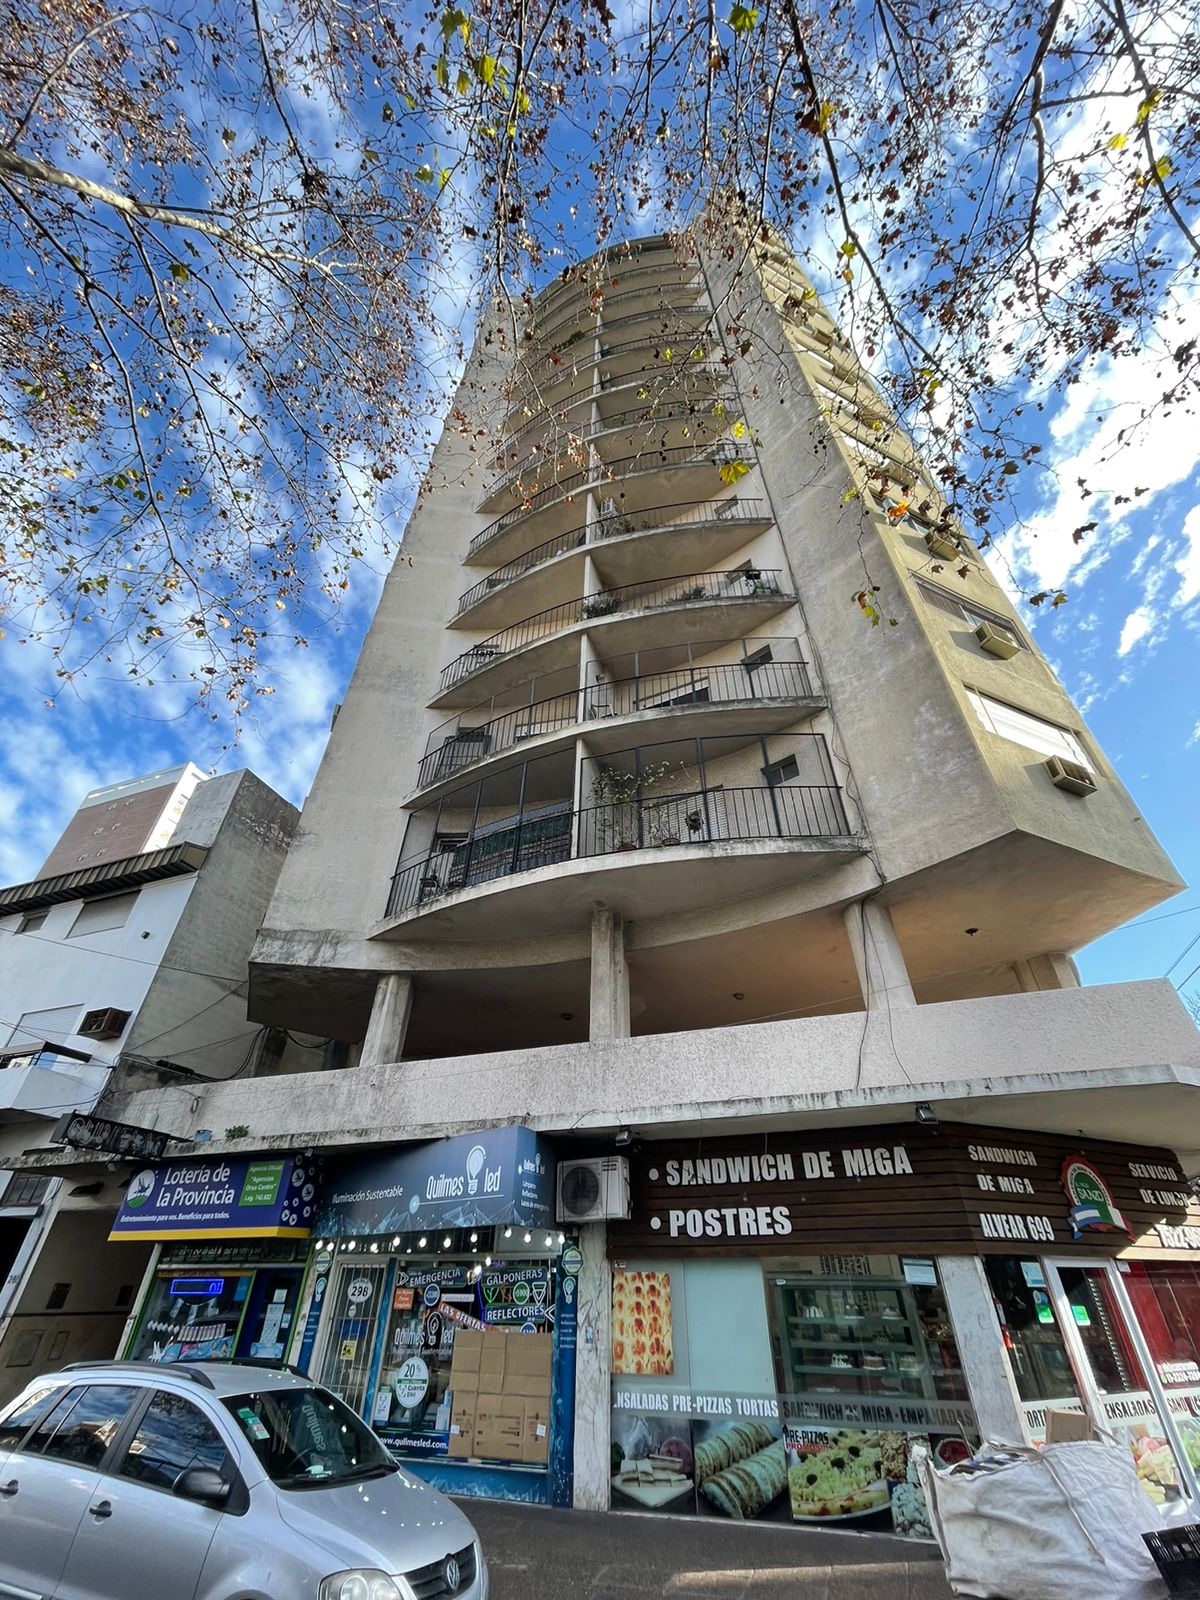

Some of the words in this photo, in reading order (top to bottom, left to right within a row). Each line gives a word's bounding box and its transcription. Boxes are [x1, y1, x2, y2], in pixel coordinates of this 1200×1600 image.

[968, 1145, 1038, 1166] SANDWICH
[163, 1163, 209, 1186] Lotería
[212, 1163, 231, 1183] de
[666, 1153, 795, 1186] SANDWICH
[802, 1151, 836, 1180] DE
[841, 1146, 914, 1177] MIGA
[1128, 1162, 1178, 1181] SERVICIO
[426, 1173, 464, 1200] Quilmes
[484, 1166, 502, 1193] led
[976, 1174, 997, 1191] DE
[156, 1188, 171, 1207] la
[171, 1183, 235, 1207] Provincia
[331, 1191, 366, 1204] Iluminación
[366, 1185, 404, 1201] Sustentable
[1139, 1189, 1157, 1204] DE
[1155, 1190, 1190, 1208] LUNCH
[156, 1214, 168, 1222] para
[178, 1212, 202, 1221] Beneficios
[202, 1213, 214, 1222] para
[669, 1206, 793, 1238] POSTRES
[980, 1213, 1028, 1239] ALVEAR
[1026, 1215, 1055, 1241] 699
[410, 1268, 460, 1287] EMERGENCIA
[486, 1269, 543, 1286] GALPONERAS
[351, 1286, 369, 1297] 298
[440, 1304, 455, 1317] LAS
[456, 1312, 487, 1332] OFERTAS
[487, 1305, 545, 1320] REFLECTORES
[394, 1327, 425, 1346] Quilmes
[441, 1327, 454, 1344] led
[404, 1363, 416, 1378] 20
[672, 1394, 733, 1415] PRE-PIZZAS
[736, 1398, 779, 1418] TORTAS
[1104, 1400, 1156, 1420] ENSALADAS
[861, 1405, 894, 1424] MIGA
[899, 1406, 974, 1427] EMPANADAS
[783, 1428, 829, 1445] PRE-PIZZAS
